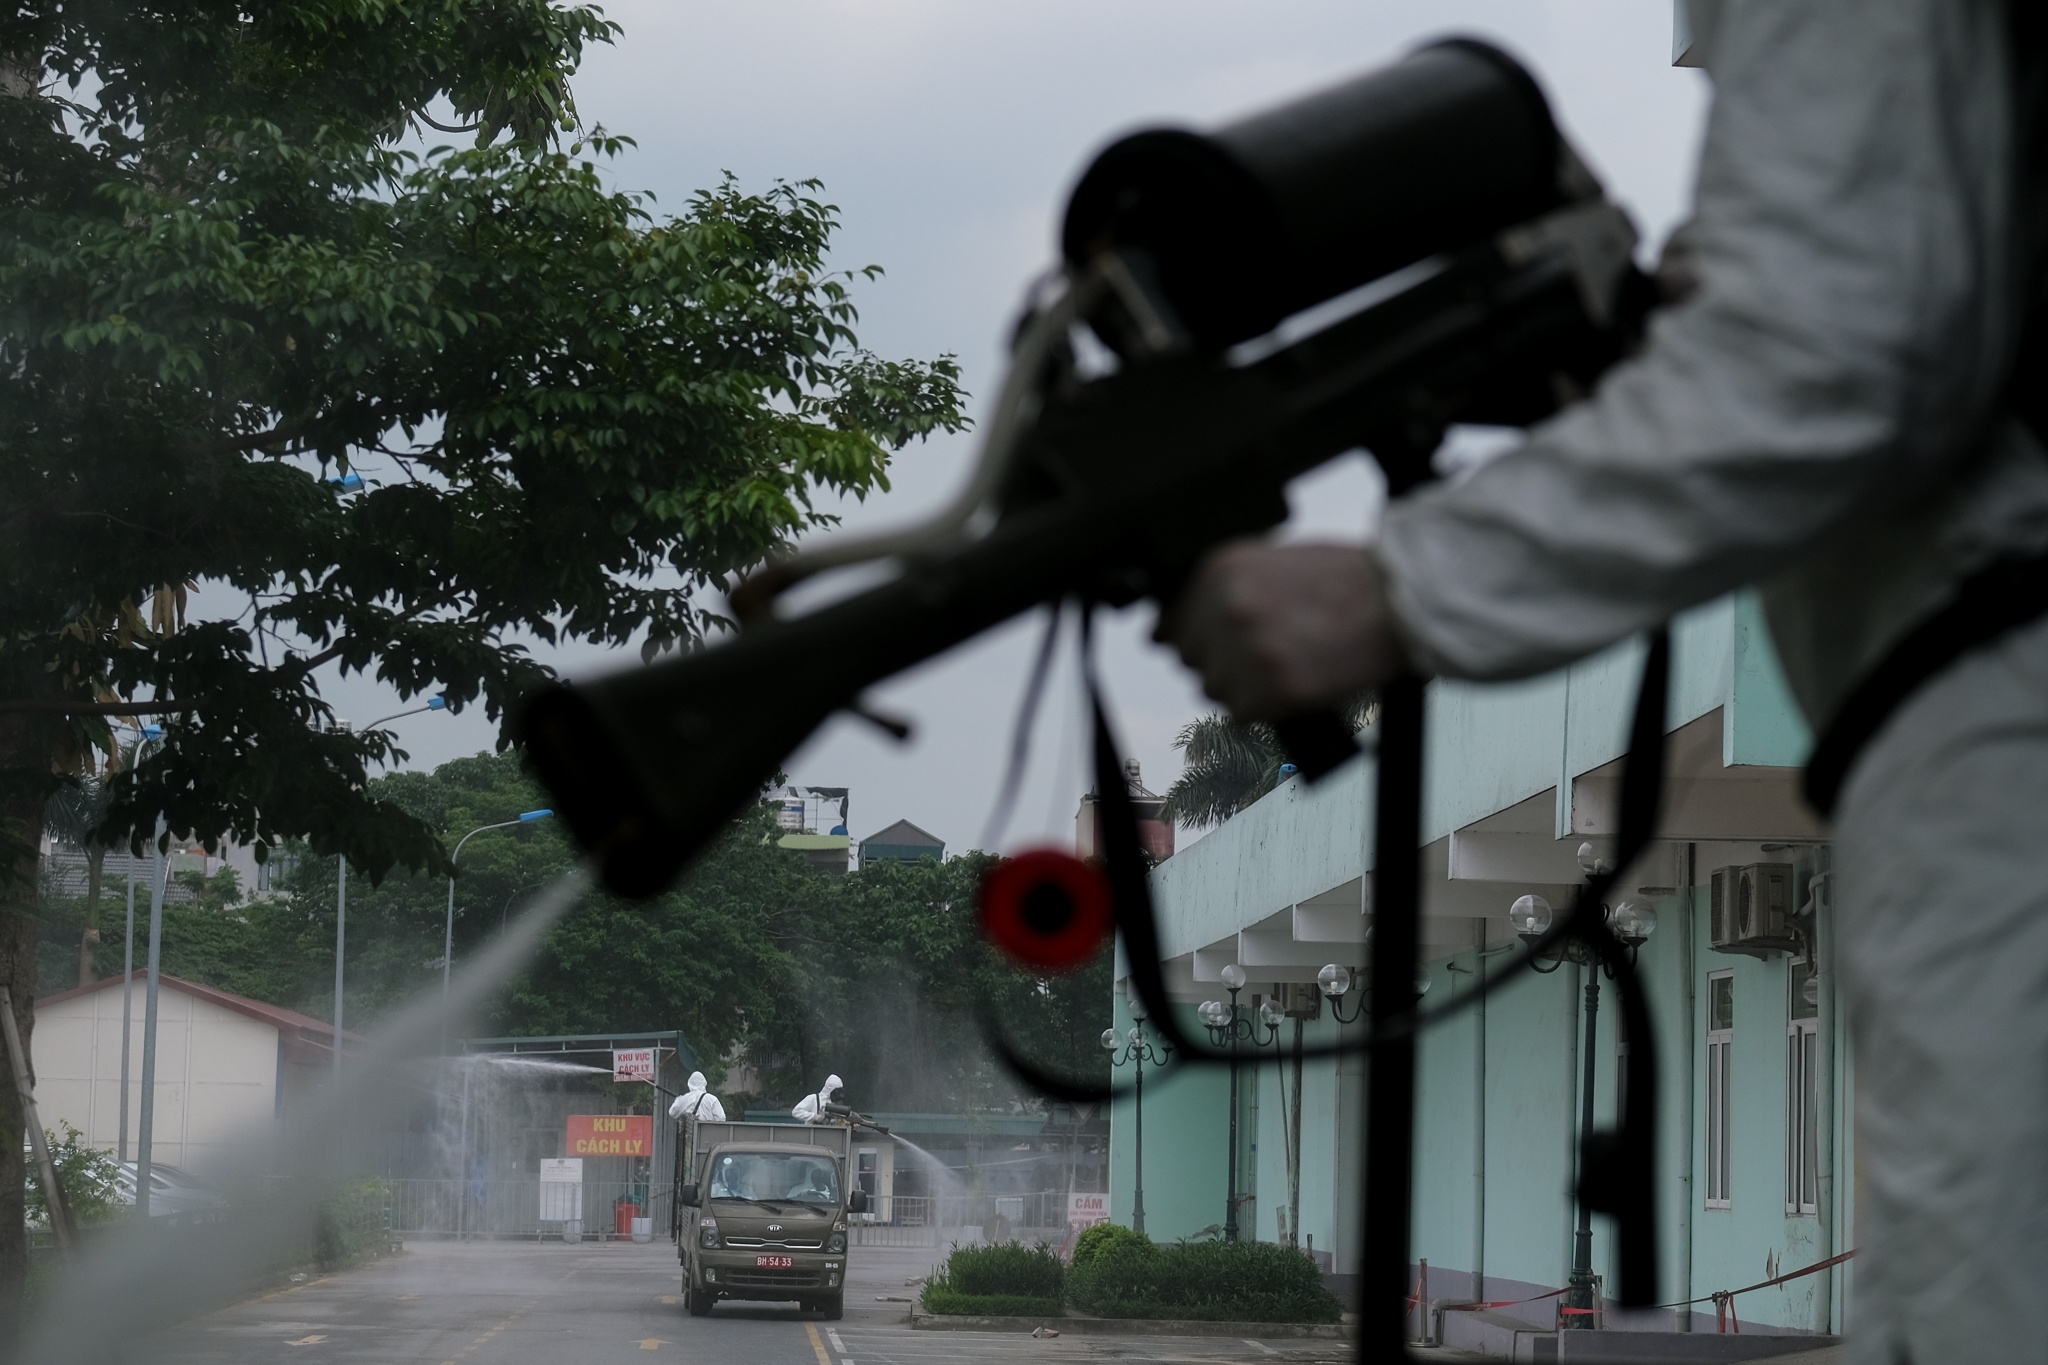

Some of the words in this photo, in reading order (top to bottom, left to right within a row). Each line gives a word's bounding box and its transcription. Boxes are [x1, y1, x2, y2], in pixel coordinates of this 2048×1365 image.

[617, 1053, 633, 1062] KHU
[634, 1052, 650, 1063] VỰC
[619, 1064, 640, 1073] CÁCH
[641, 1064, 650, 1073] LY
[593, 1118, 626, 1132] KHU
[576, 1136, 620, 1153] CÁCH
[625, 1139, 643, 1153] LY
[1075, 1195, 1102, 1209] CẤM
